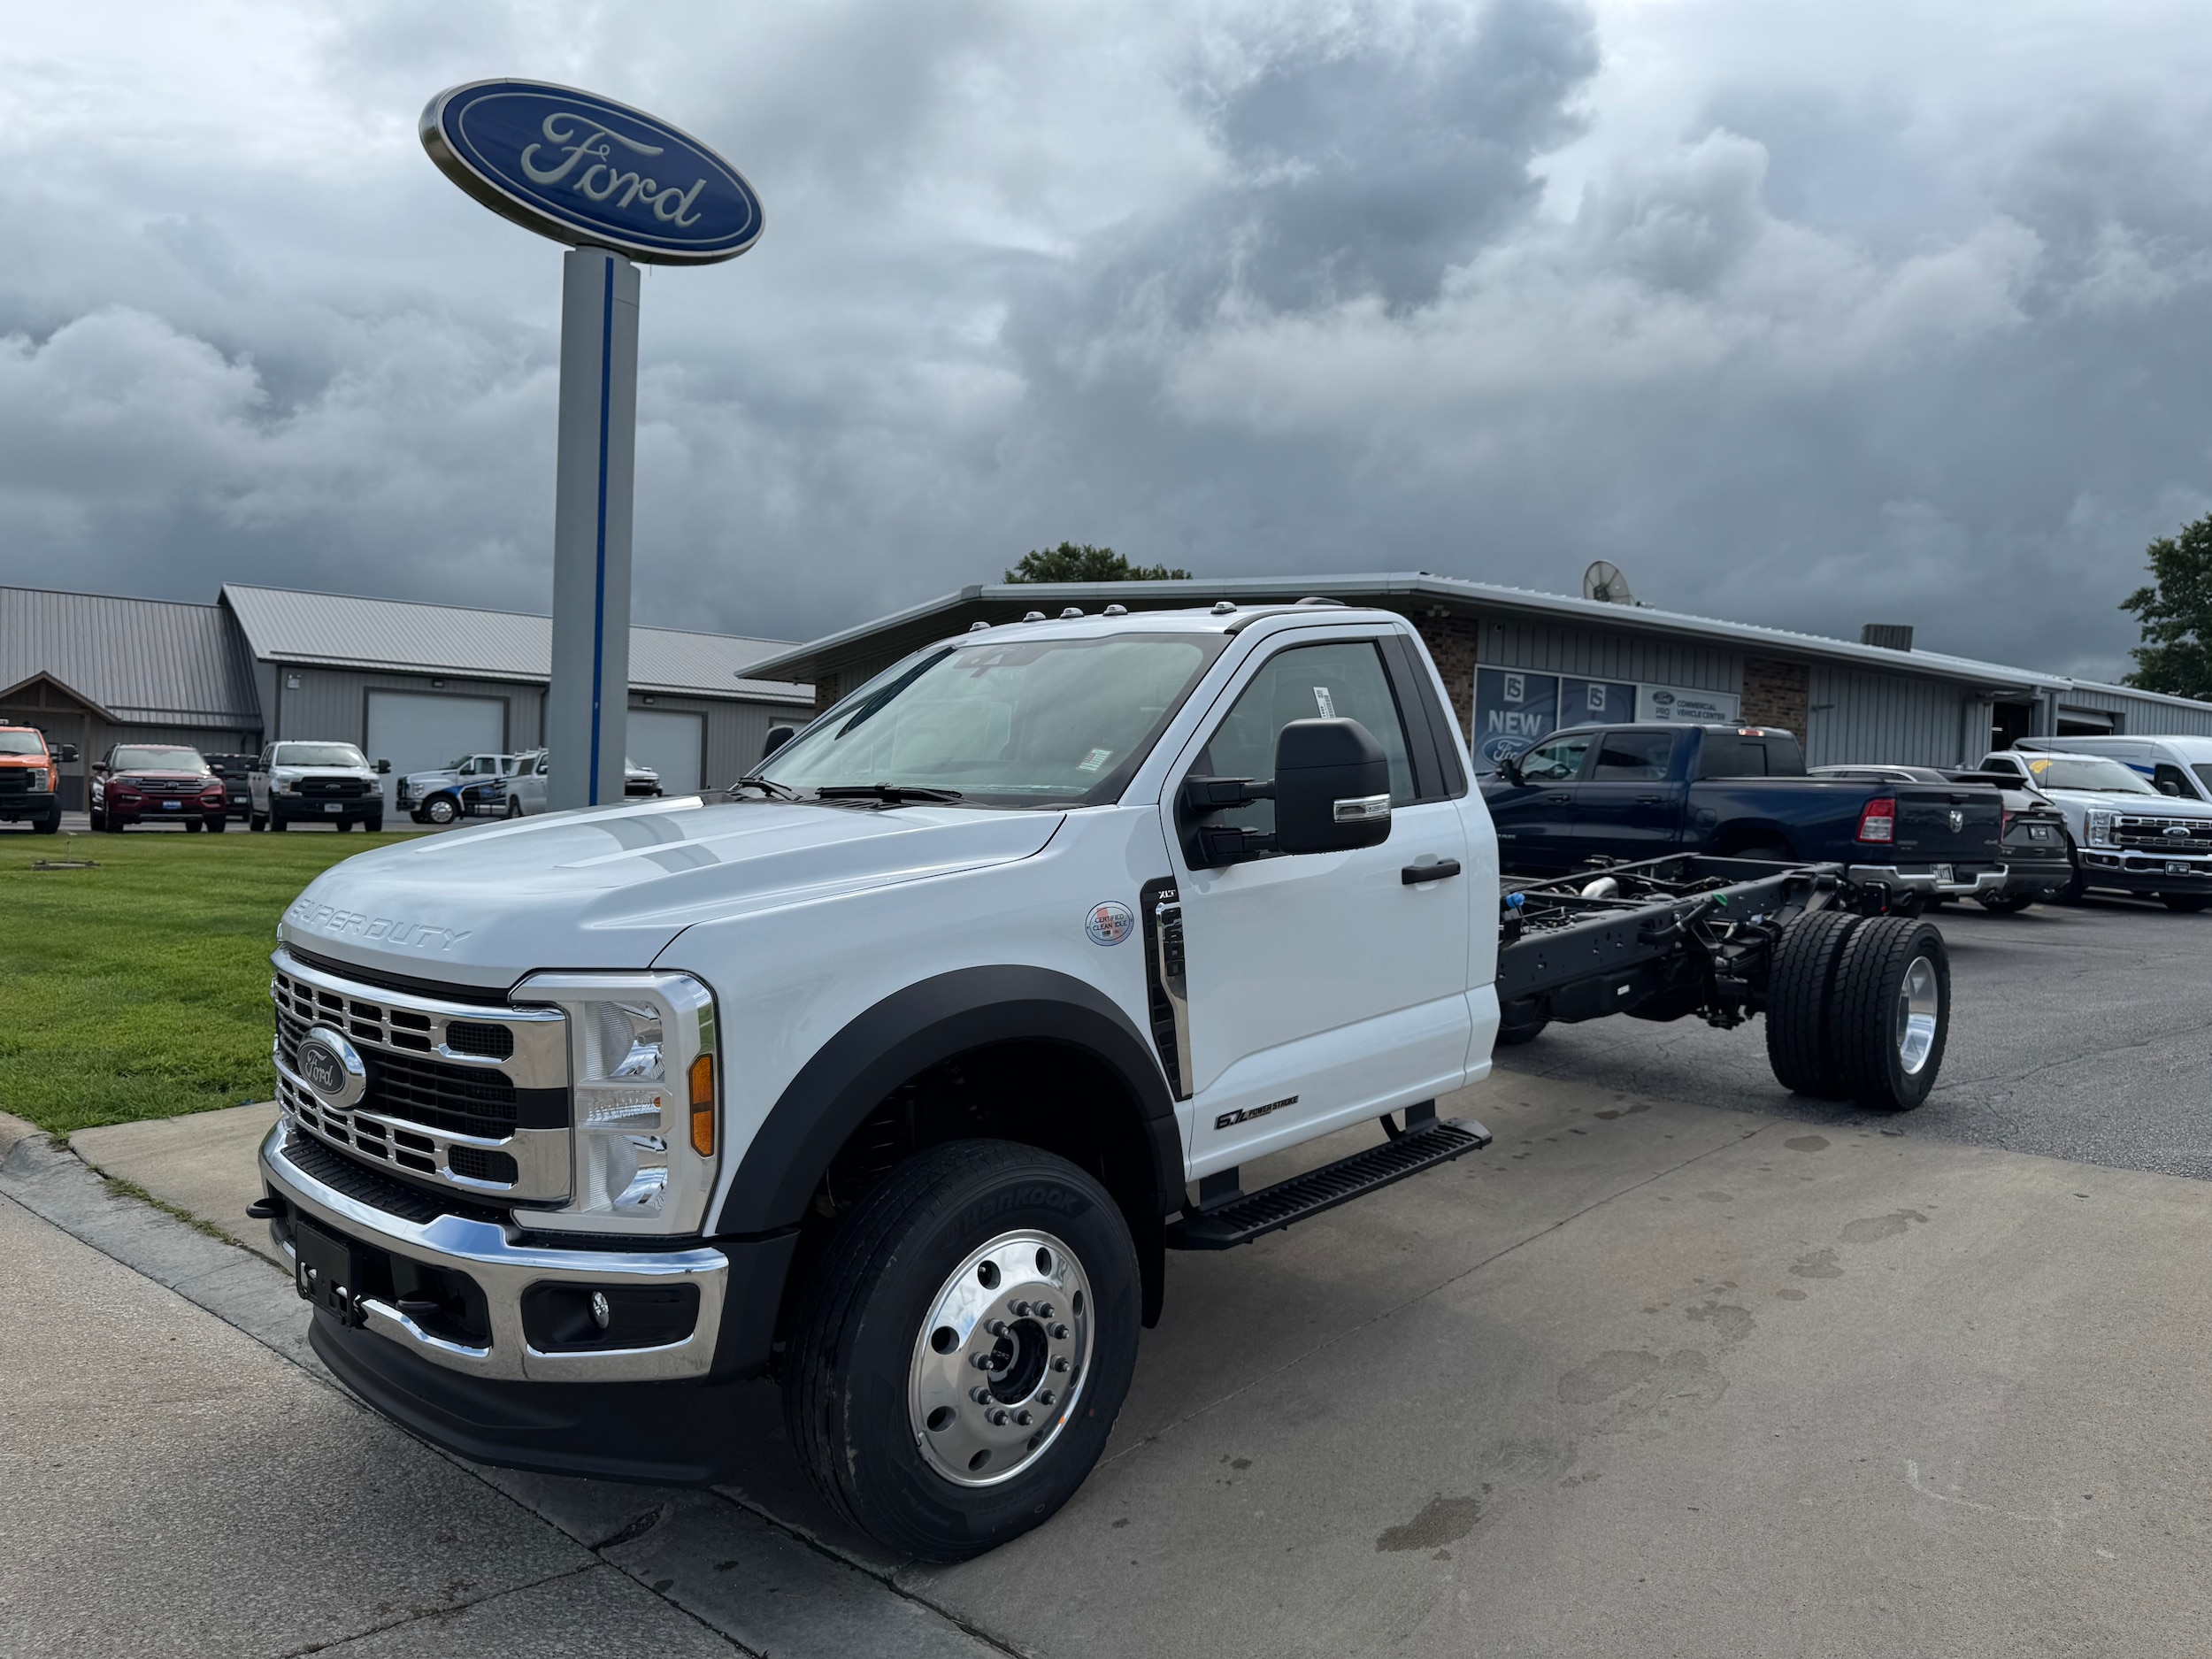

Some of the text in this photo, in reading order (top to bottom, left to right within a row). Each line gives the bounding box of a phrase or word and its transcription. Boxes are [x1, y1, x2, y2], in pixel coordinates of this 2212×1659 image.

[520, 111, 708, 228] Ford
[1655, 707, 1670, 716] PRO
[1677, 700, 1717, 711] COMMERCIAL
[1677, 708, 1725, 720] VEHICLE CENTER
[1488, 710, 1541, 737] NEW
[1158, 889, 1176, 900] XLT
[290, 898, 472, 951] SUPER DUTY
[1094, 914, 1125, 924] CERTIFIED
[304, 1048, 334, 1087] Ford
[1248, 1104, 1272, 1118] POWER
[1272, 1095, 1299, 1111] STROKE
